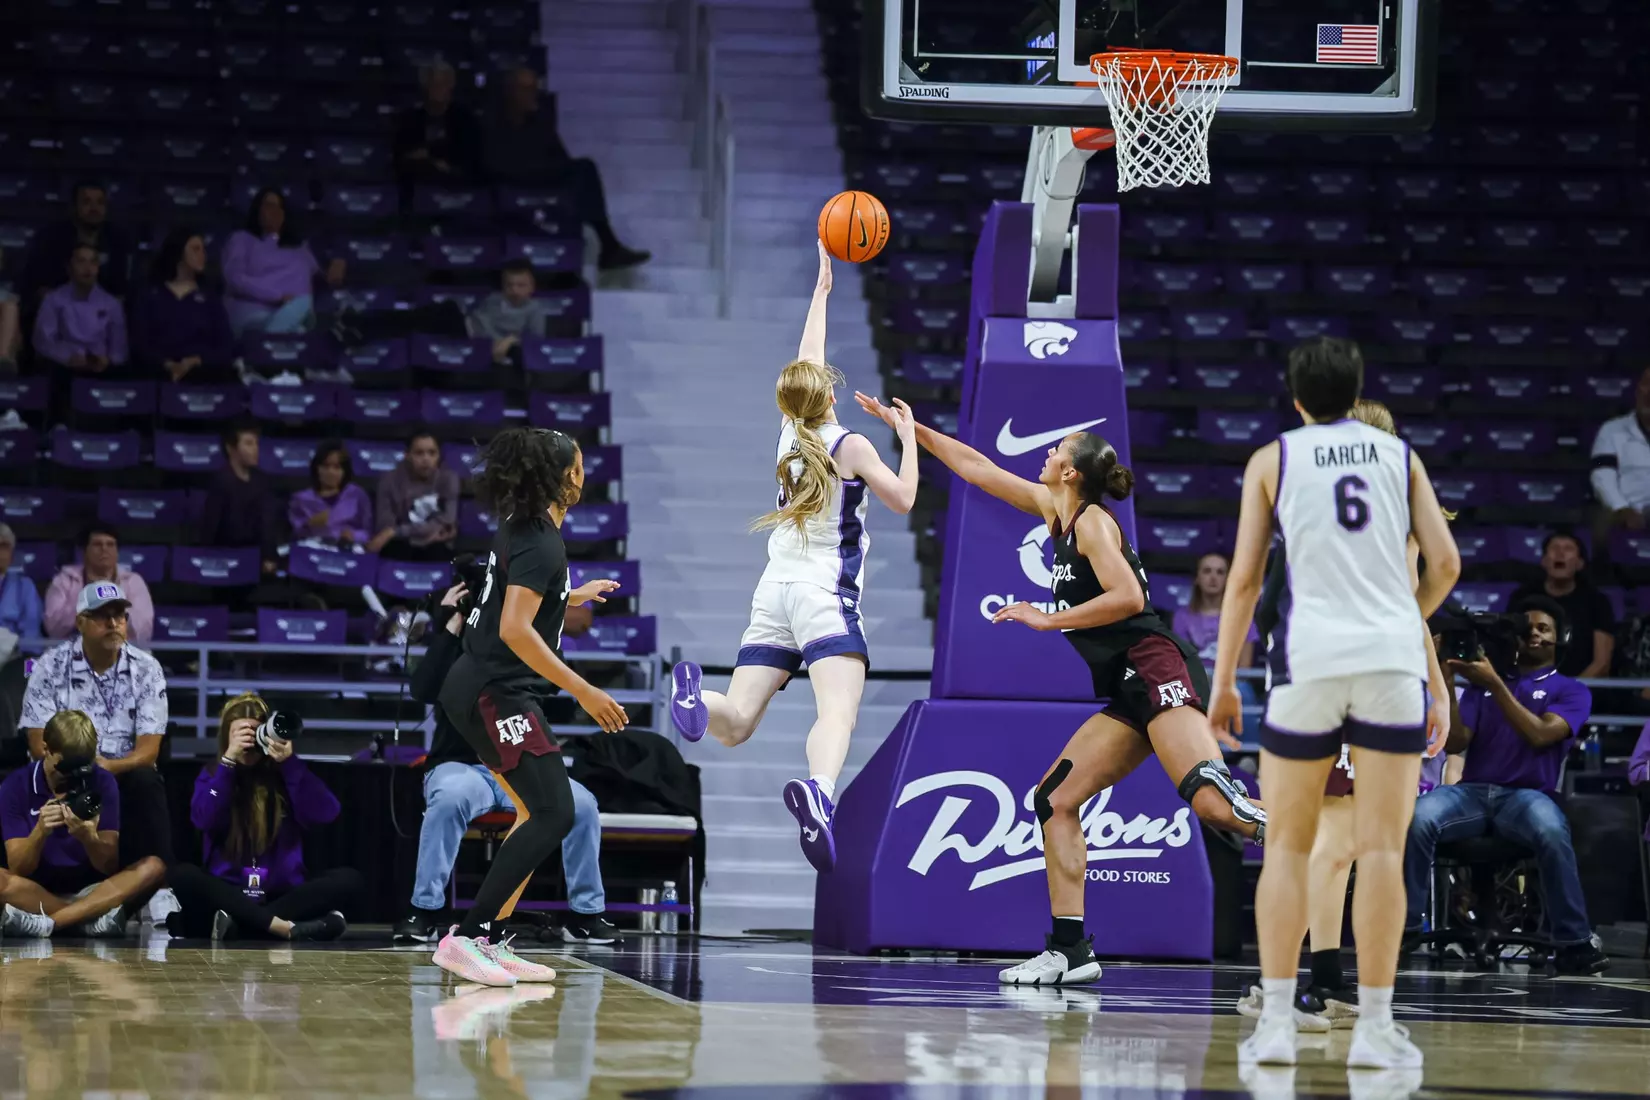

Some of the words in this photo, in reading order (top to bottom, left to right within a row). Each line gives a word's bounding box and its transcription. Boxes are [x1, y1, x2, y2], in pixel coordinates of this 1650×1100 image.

[899, 86, 950, 99] SPALDING
[1333, 474, 1371, 533] 6
[1084, 868, 1120, 882] FOOD
[1123, 870, 1171, 884] STORES
